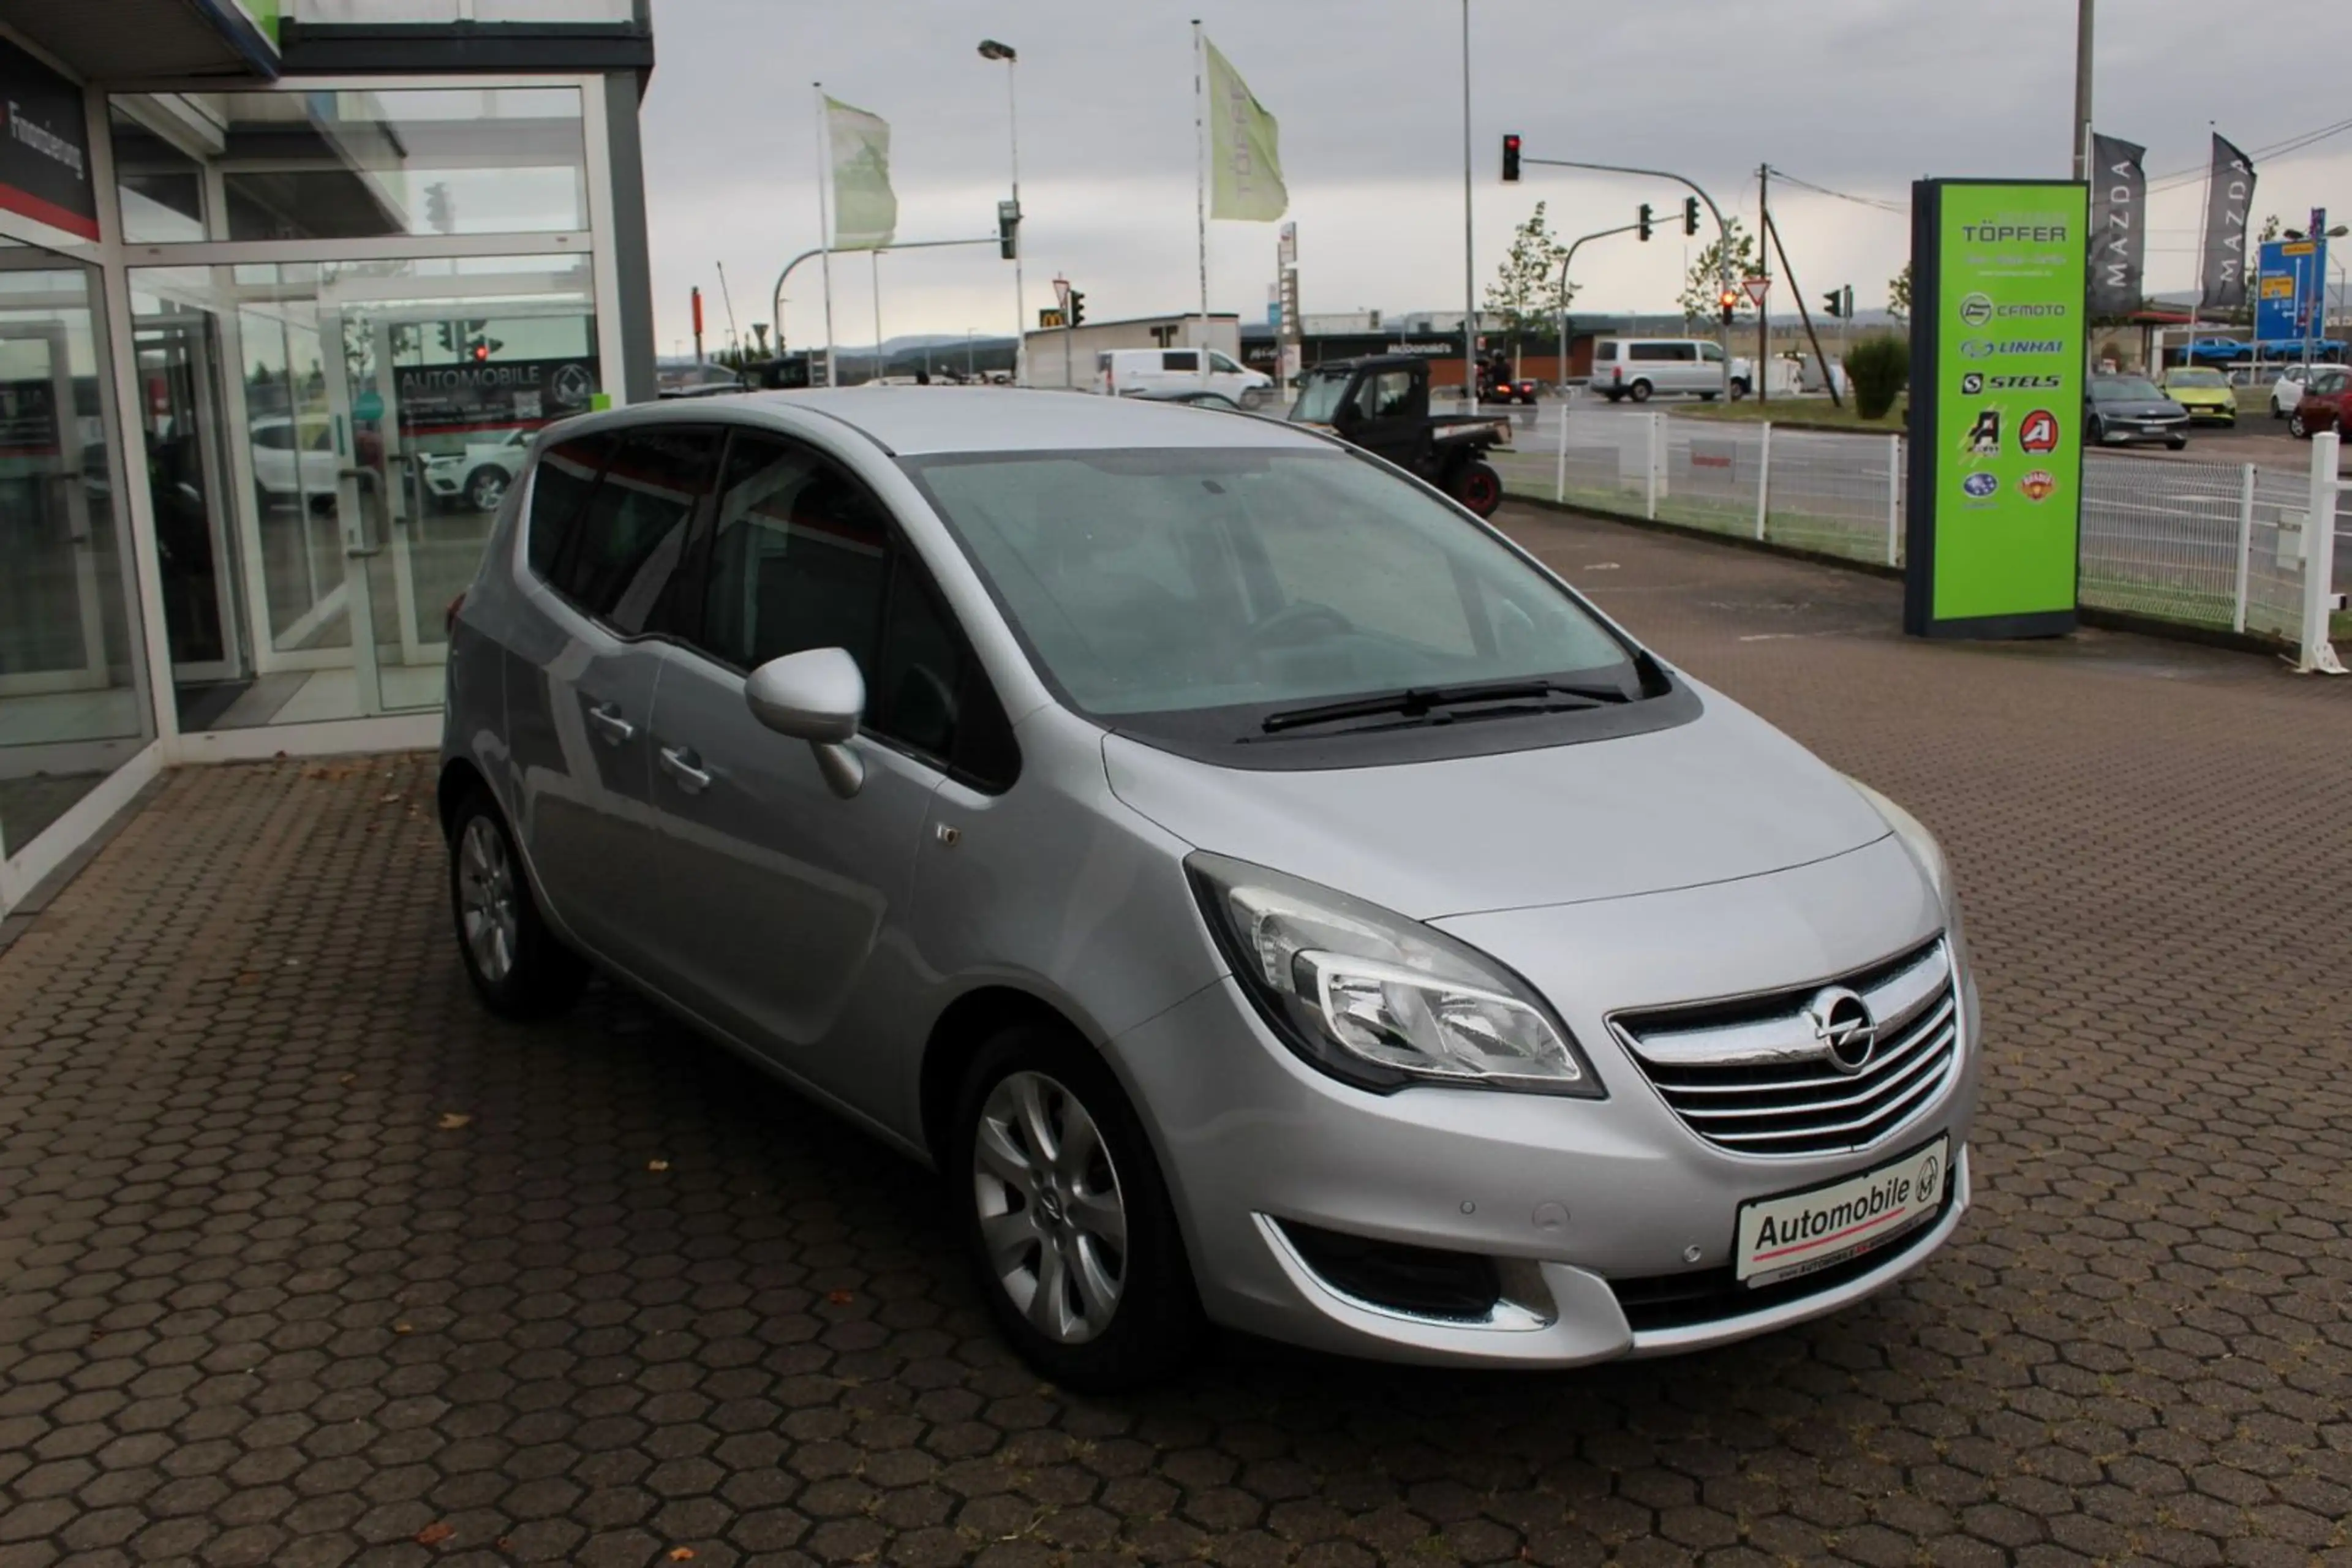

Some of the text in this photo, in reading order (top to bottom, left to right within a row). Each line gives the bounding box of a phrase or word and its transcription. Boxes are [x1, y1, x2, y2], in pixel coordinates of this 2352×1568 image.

[1962, 219, 2067, 243] TÖPFER
[2107, 160, 2131, 287] MAZDA
[2220, 159, 2248, 282] MAZDA
[1997, 304, 2066, 317] CFMOTO
[1387, 343, 1452, 353] McDonald's
[1999, 341, 2063, 353] LINHAI
[402, 366, 540, 388] AUTOMOBILE
[1989, 375, 2062, 388] STELS
[1754, 1178, 1910, 1250] Automobile
